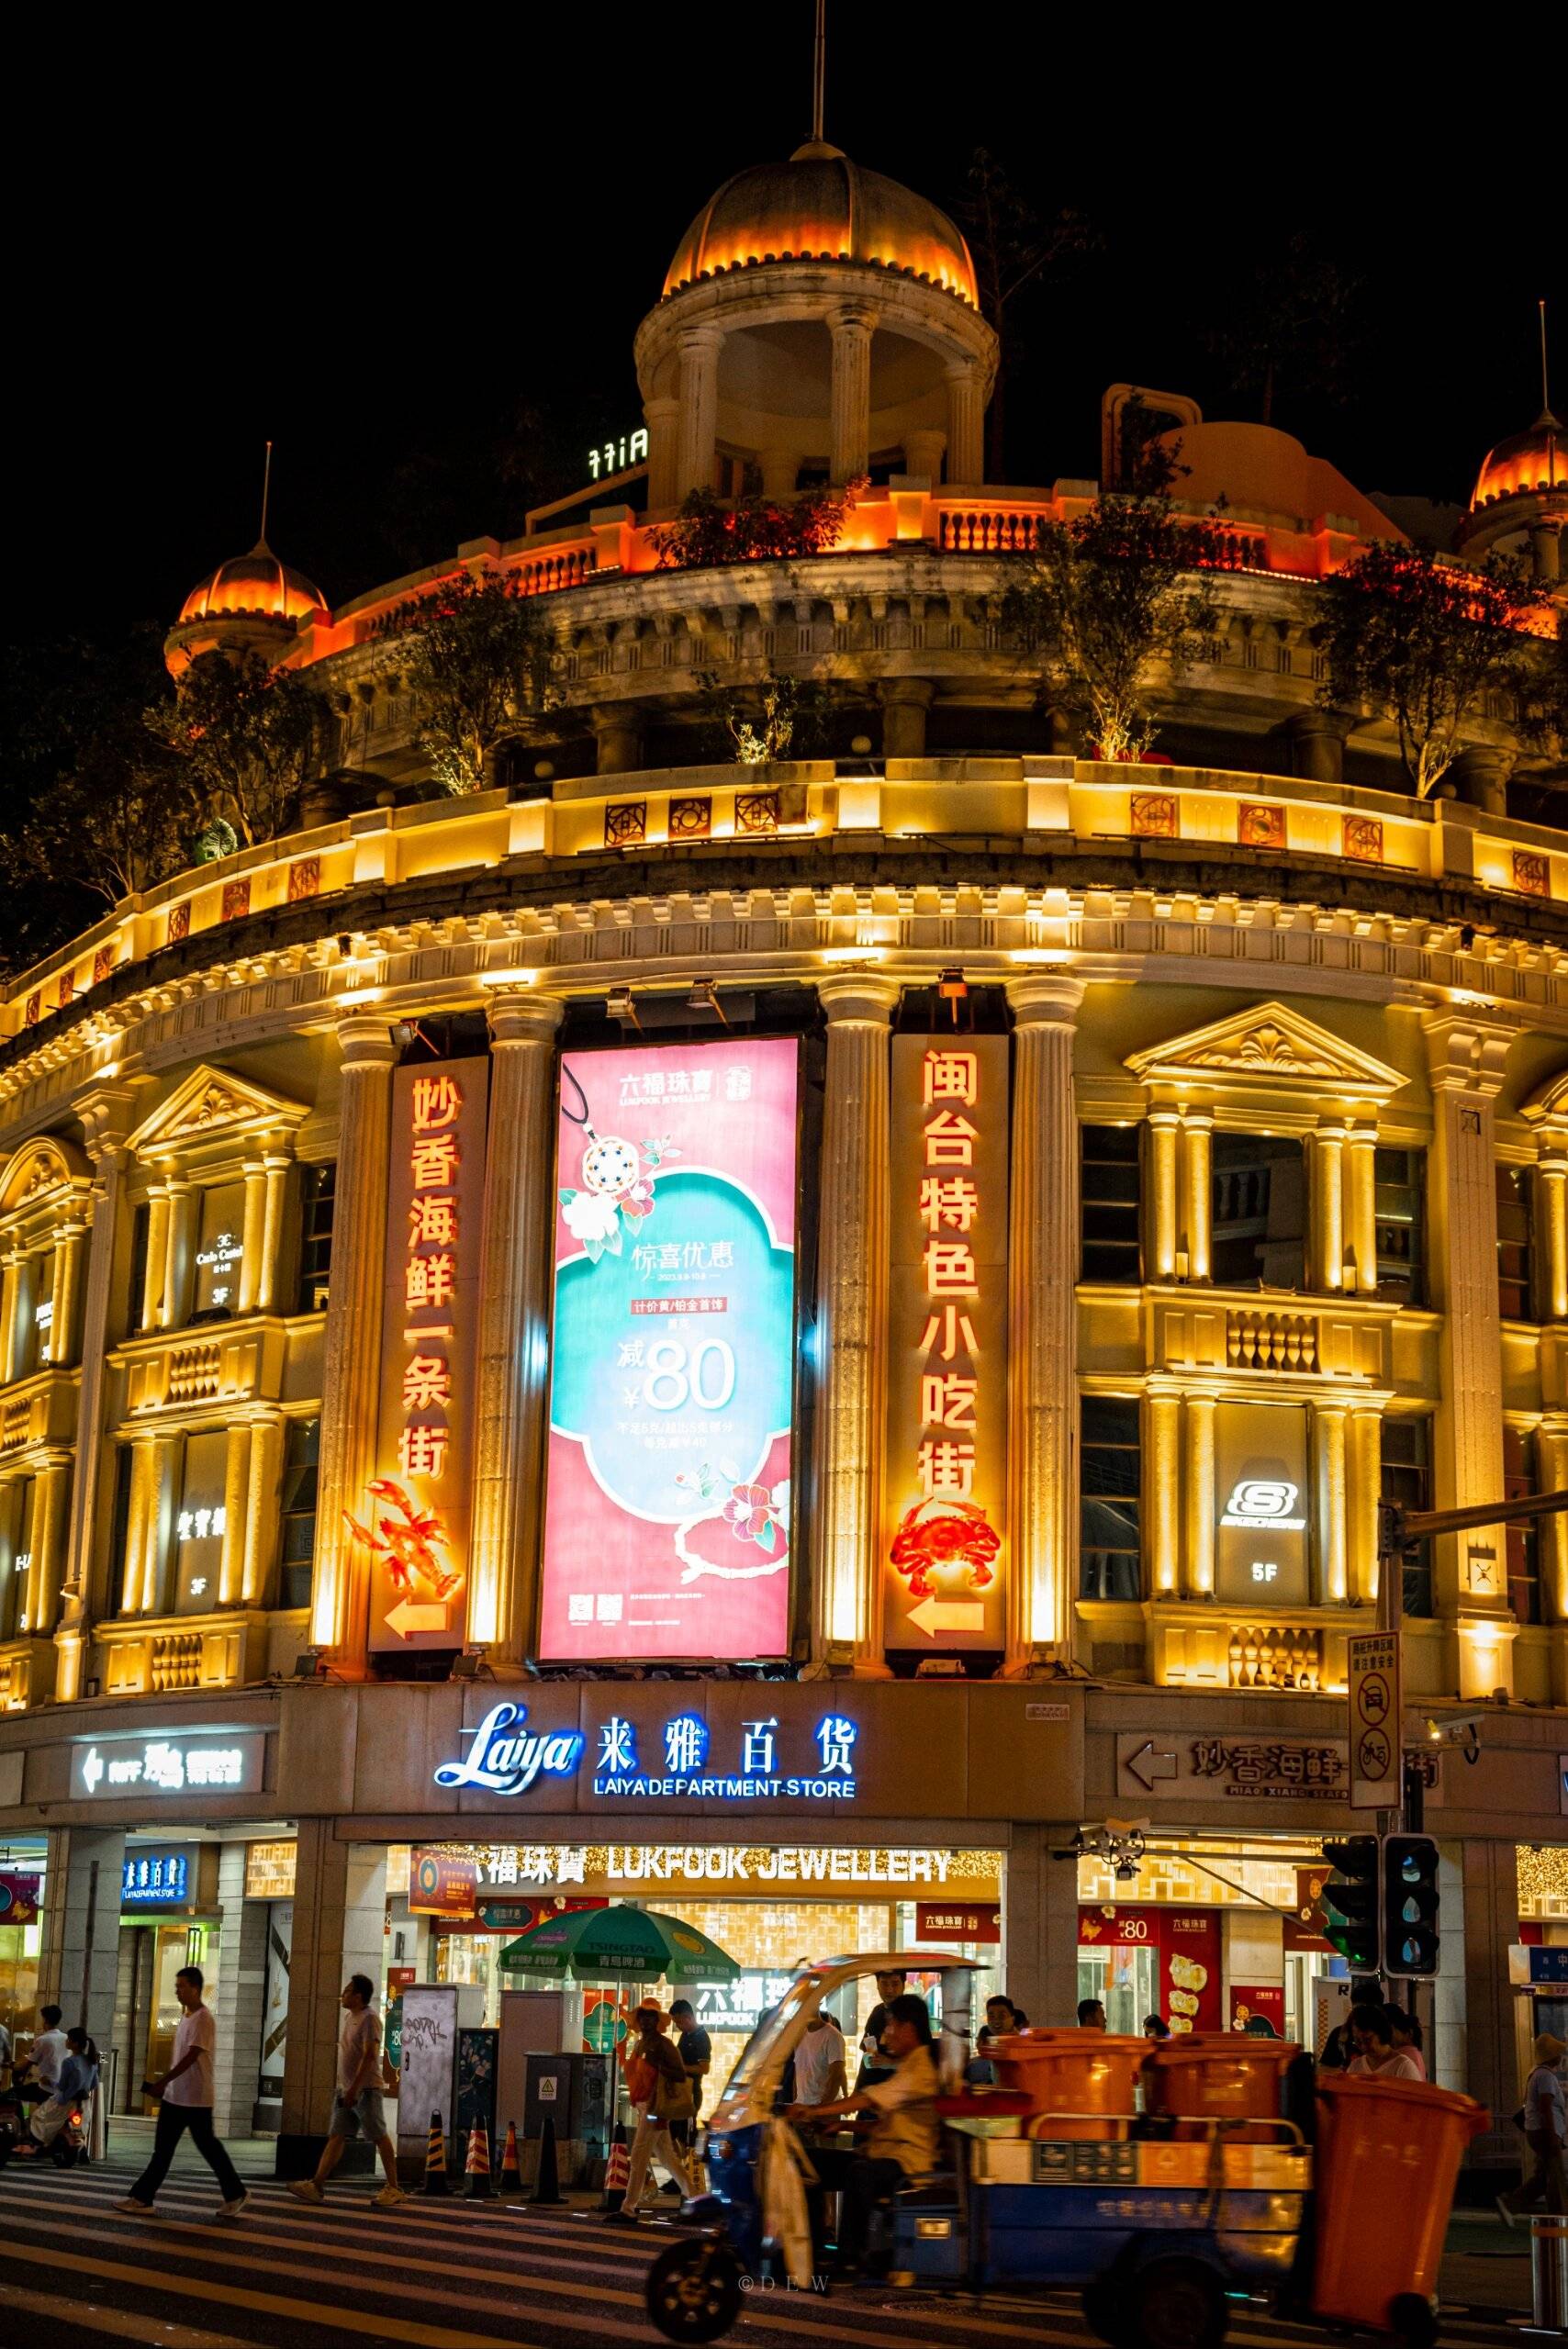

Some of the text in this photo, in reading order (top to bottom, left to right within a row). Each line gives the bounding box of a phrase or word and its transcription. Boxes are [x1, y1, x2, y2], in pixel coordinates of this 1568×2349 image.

[398, 1077, 462, 1481] 妙香海鲜一条街
[631, 1240, 734, 1281] 惊喜优惠
[918, 1049, 979, 1496] 闽台特色小吃街
[643, 1337, 735, 1411] 80
[1252, 1563, 1278, 1582] 5F
[434, 1702, 571, 1795] Laiya
[597, 1717, 857, 1774] 来雅百货
[1228, 1785, 1260, 1796] MIAO
[1268, 1787, 1306, 1798] XIANG
[608, 1845, 951, 1882] LUKFOOK JEWELLERY
[588, 1941, 655, 1953] TSINGTAO
